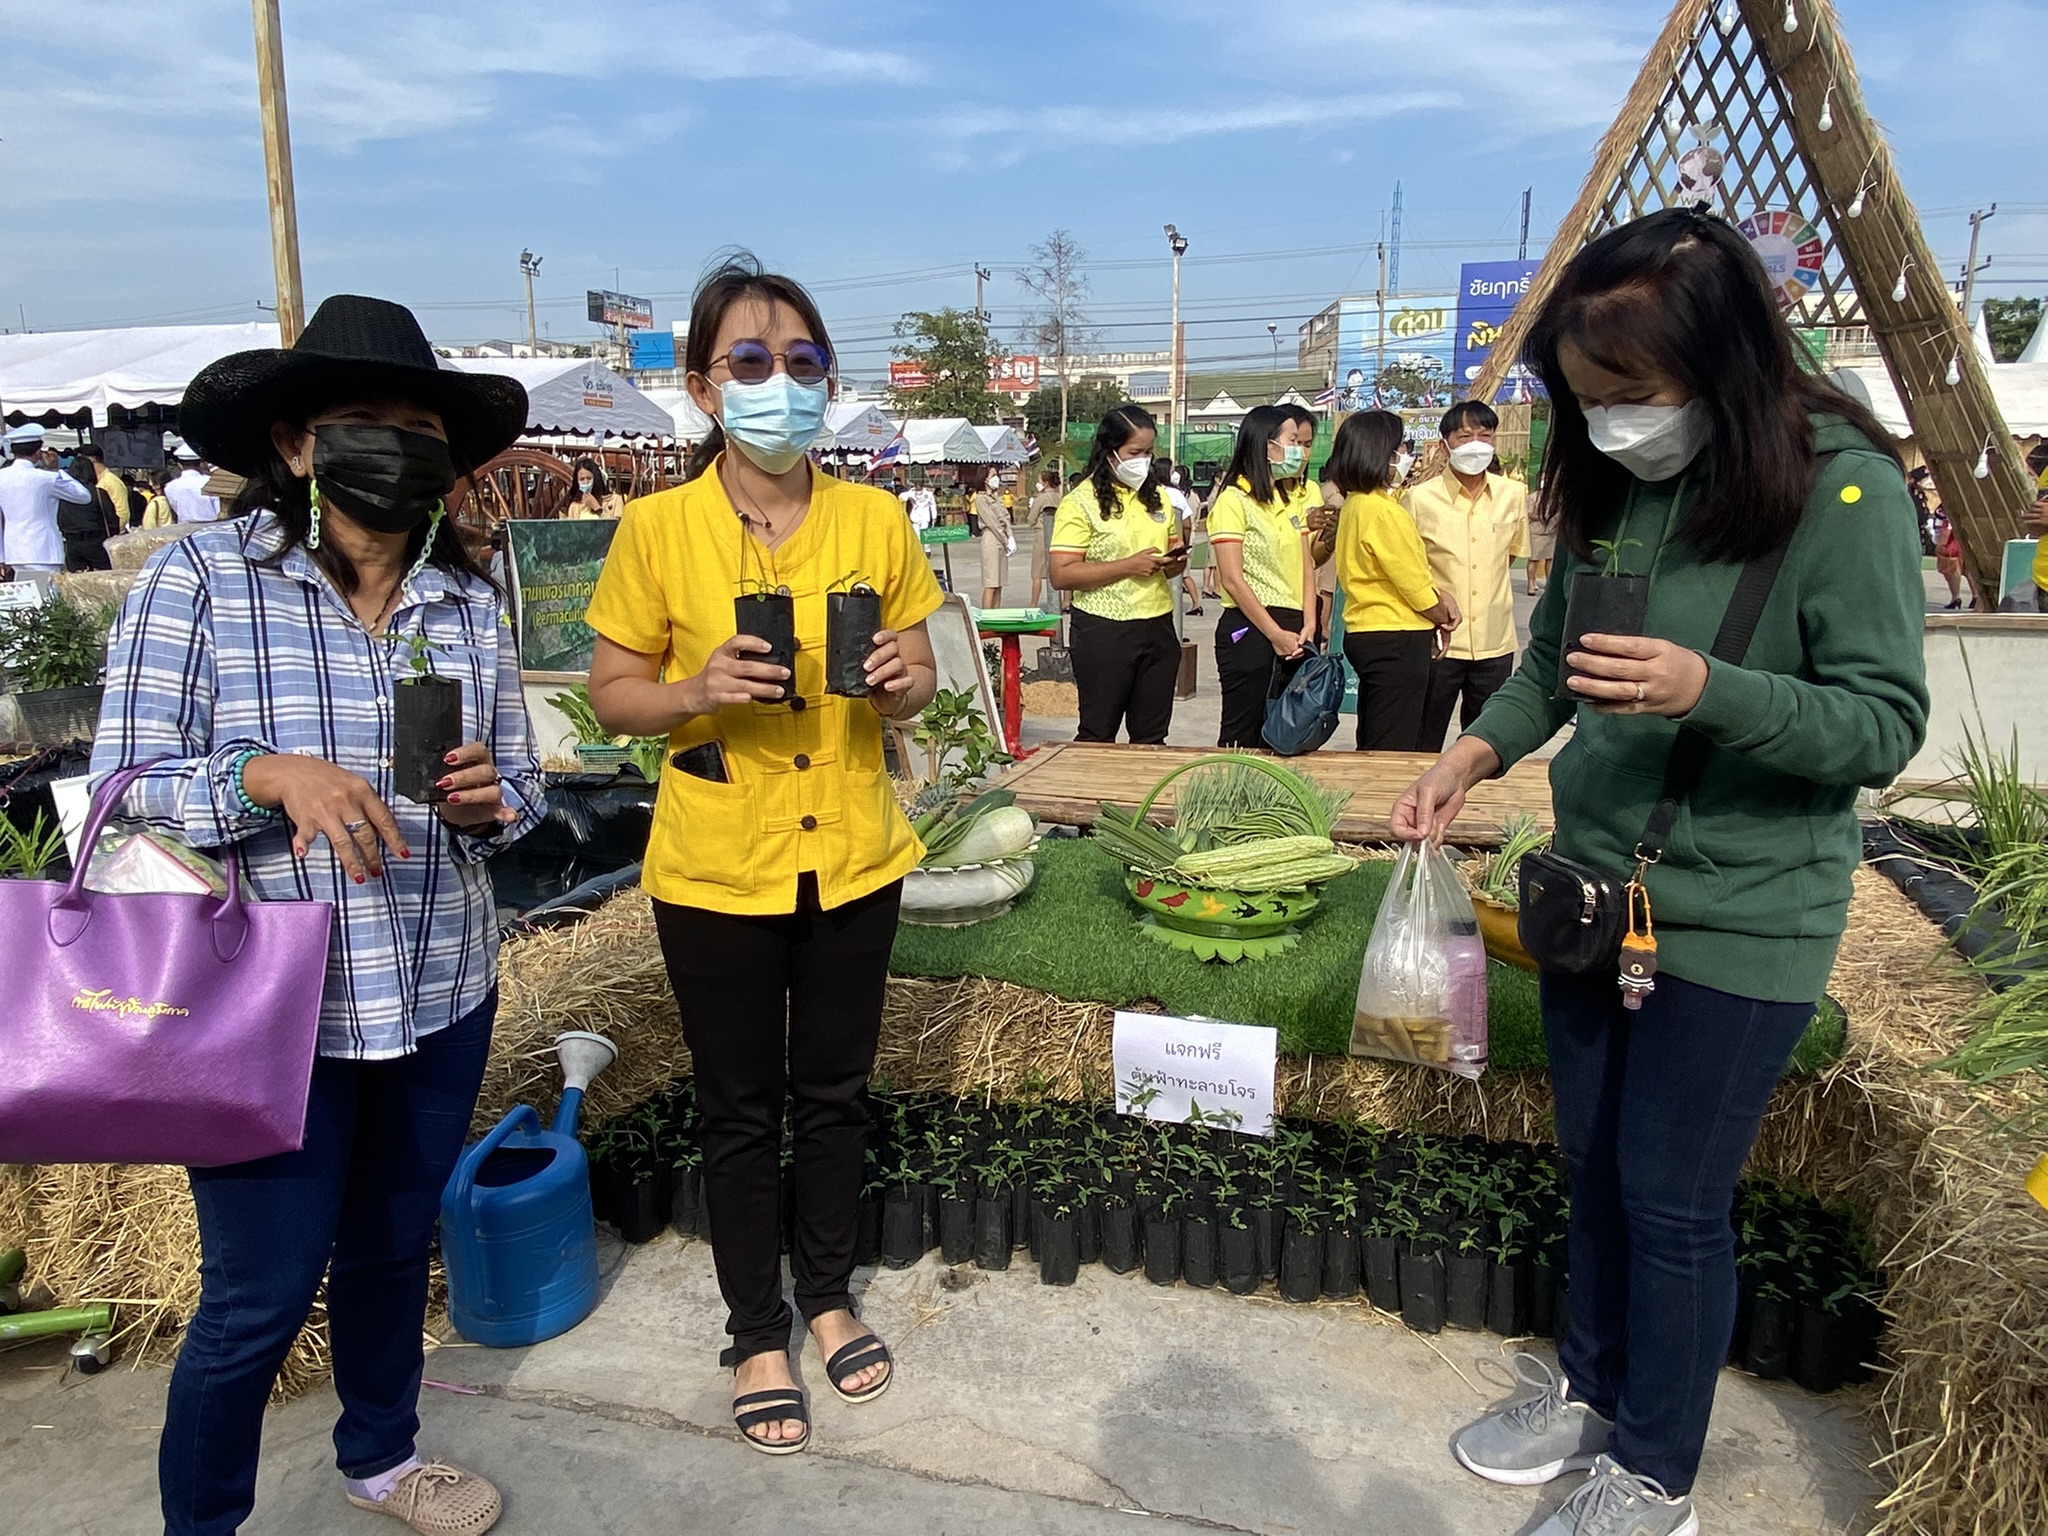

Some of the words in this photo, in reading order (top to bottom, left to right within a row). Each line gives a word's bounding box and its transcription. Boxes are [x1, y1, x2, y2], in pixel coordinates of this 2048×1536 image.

[1394, 308, 1447, 340] ด่วน
[1165, 1041, 1222, 1061] แจกฟรี
